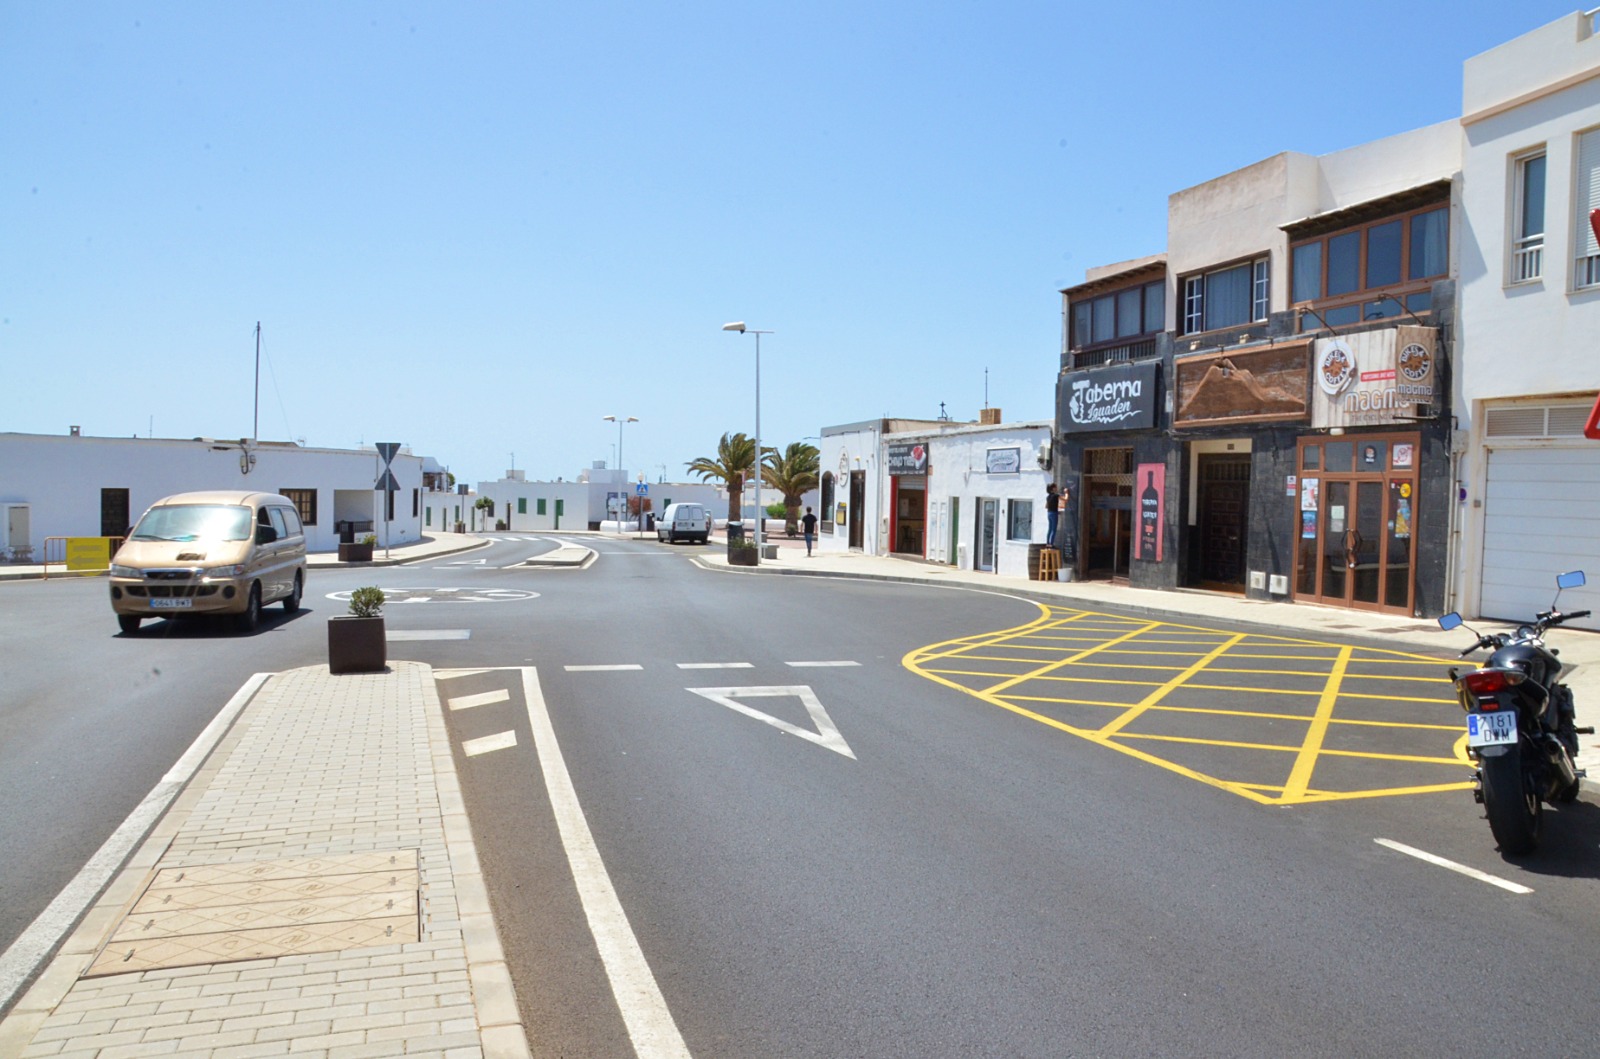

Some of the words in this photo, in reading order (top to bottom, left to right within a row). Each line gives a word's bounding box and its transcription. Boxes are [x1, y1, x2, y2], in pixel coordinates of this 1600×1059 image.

[1401, 346, 1419, 362] BIKES
[1325, 367, 1348, 385] COFFEE
[1404, 360, 1429, 378] COFFEE
[1071, 380, 1142, 406] Taberna
[1087, 398, 1131, 421] Iguaden
[1477, 713, 1512, 730] 7181
[1483, 728, 1510, 742] DWM
